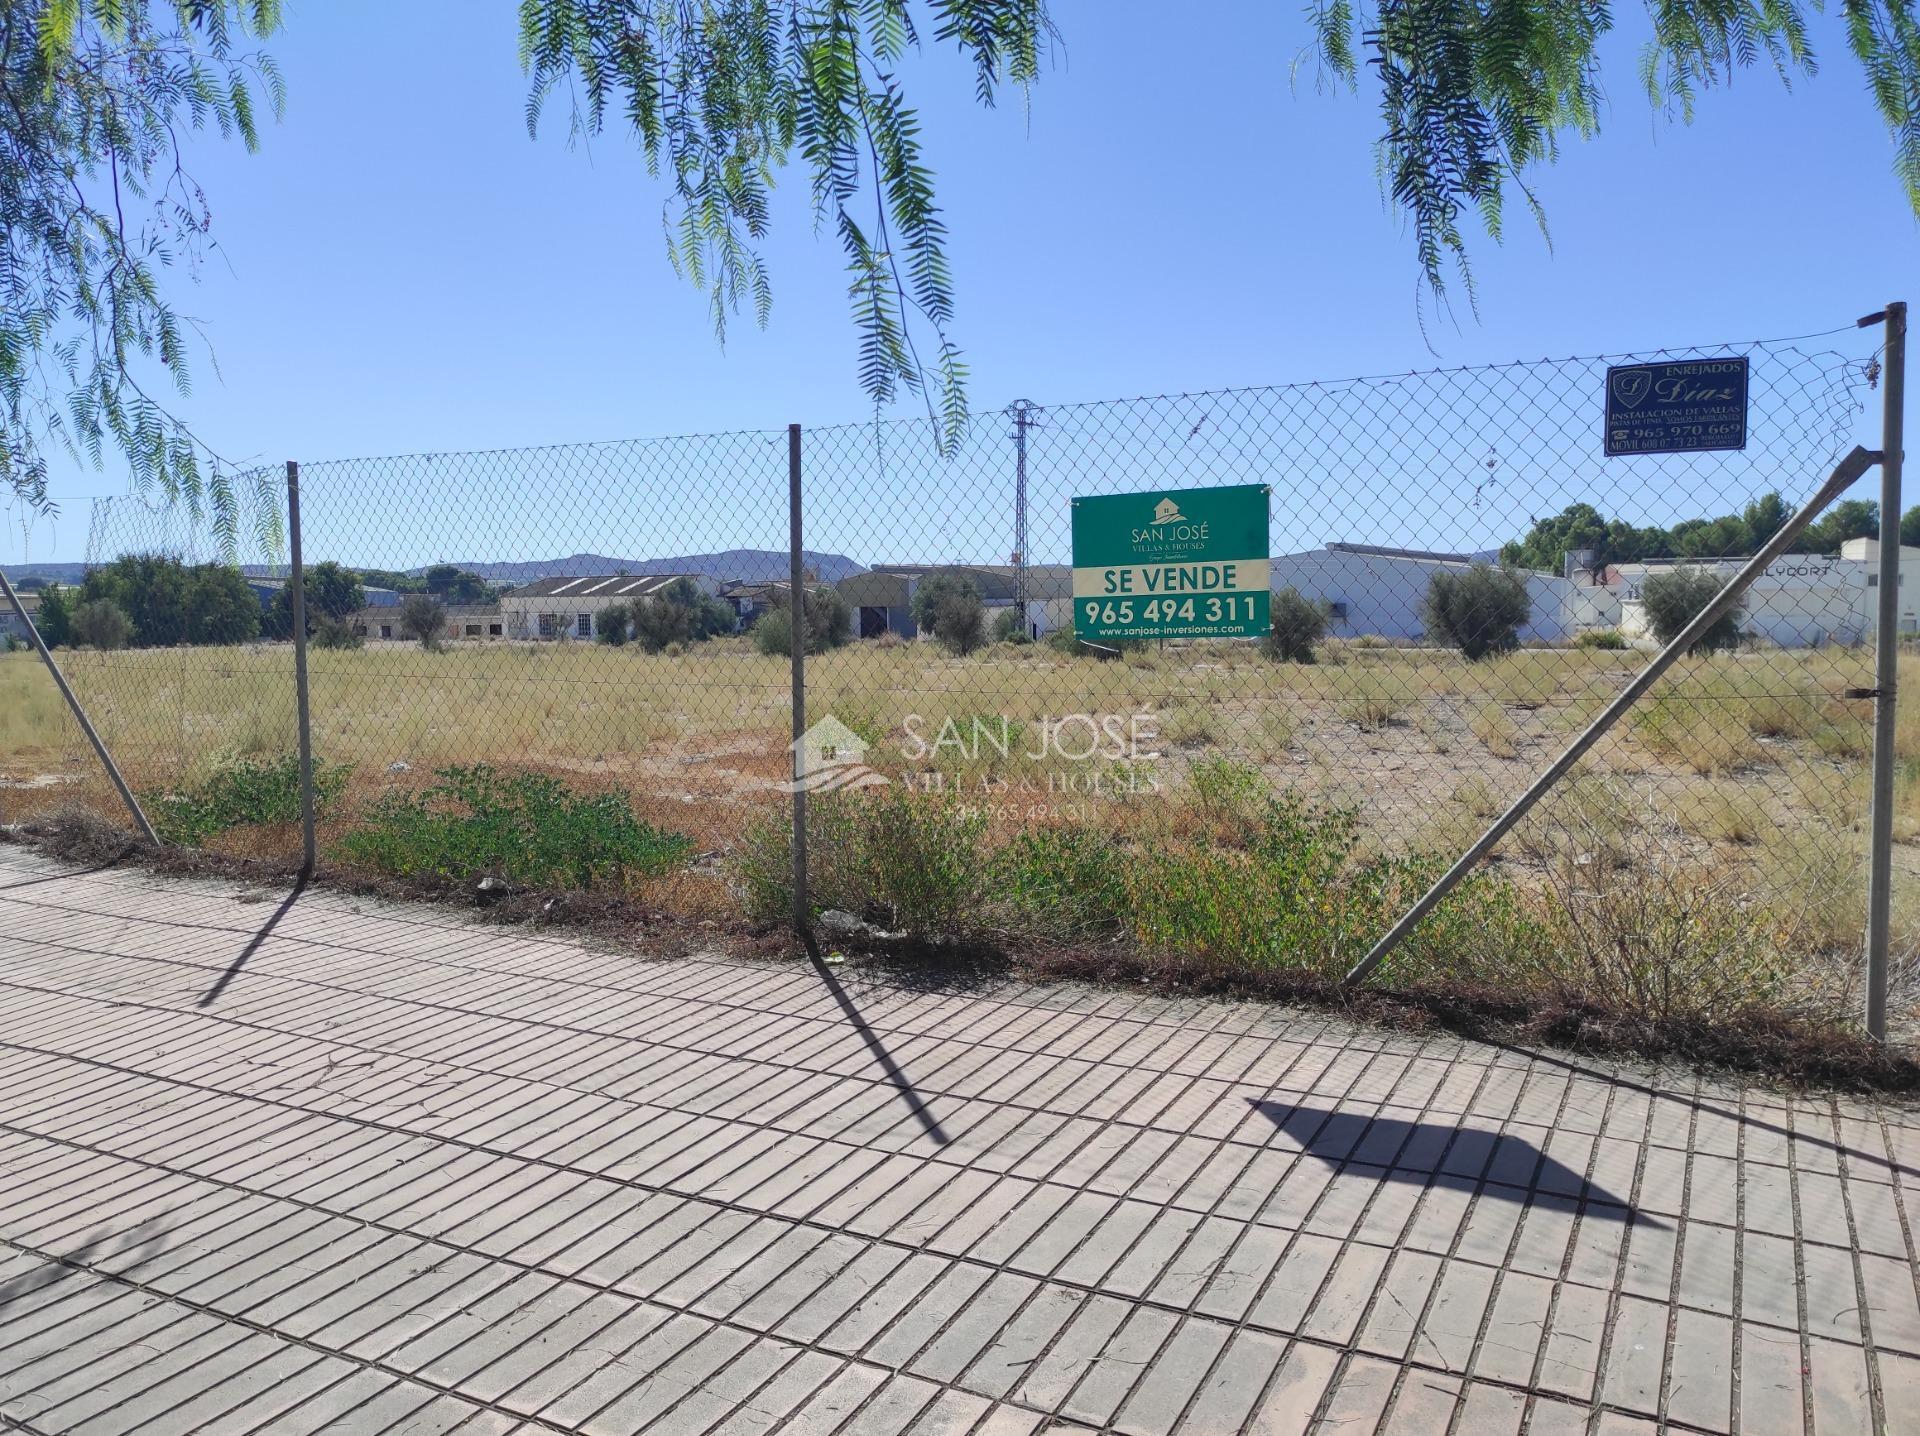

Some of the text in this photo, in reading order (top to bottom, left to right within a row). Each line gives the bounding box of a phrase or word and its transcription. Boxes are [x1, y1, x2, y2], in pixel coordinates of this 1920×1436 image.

[1666, 363, 1741, 376] ENREJADOS
[1634, 423, 1741, 438] 965 970 669
[1131, 520, 1209, 543] SAN JOSÉ
[1172, 542, 1205, 551] HOUSES
[1757, 566, 1830, 576] LYCORT
[1103, 564, 1237, 594] SE VENDE
[1085, 596, 1256, 625] 965 494 311
[1098, 624, 1244, 637] www.sanjose-inversiones.com
